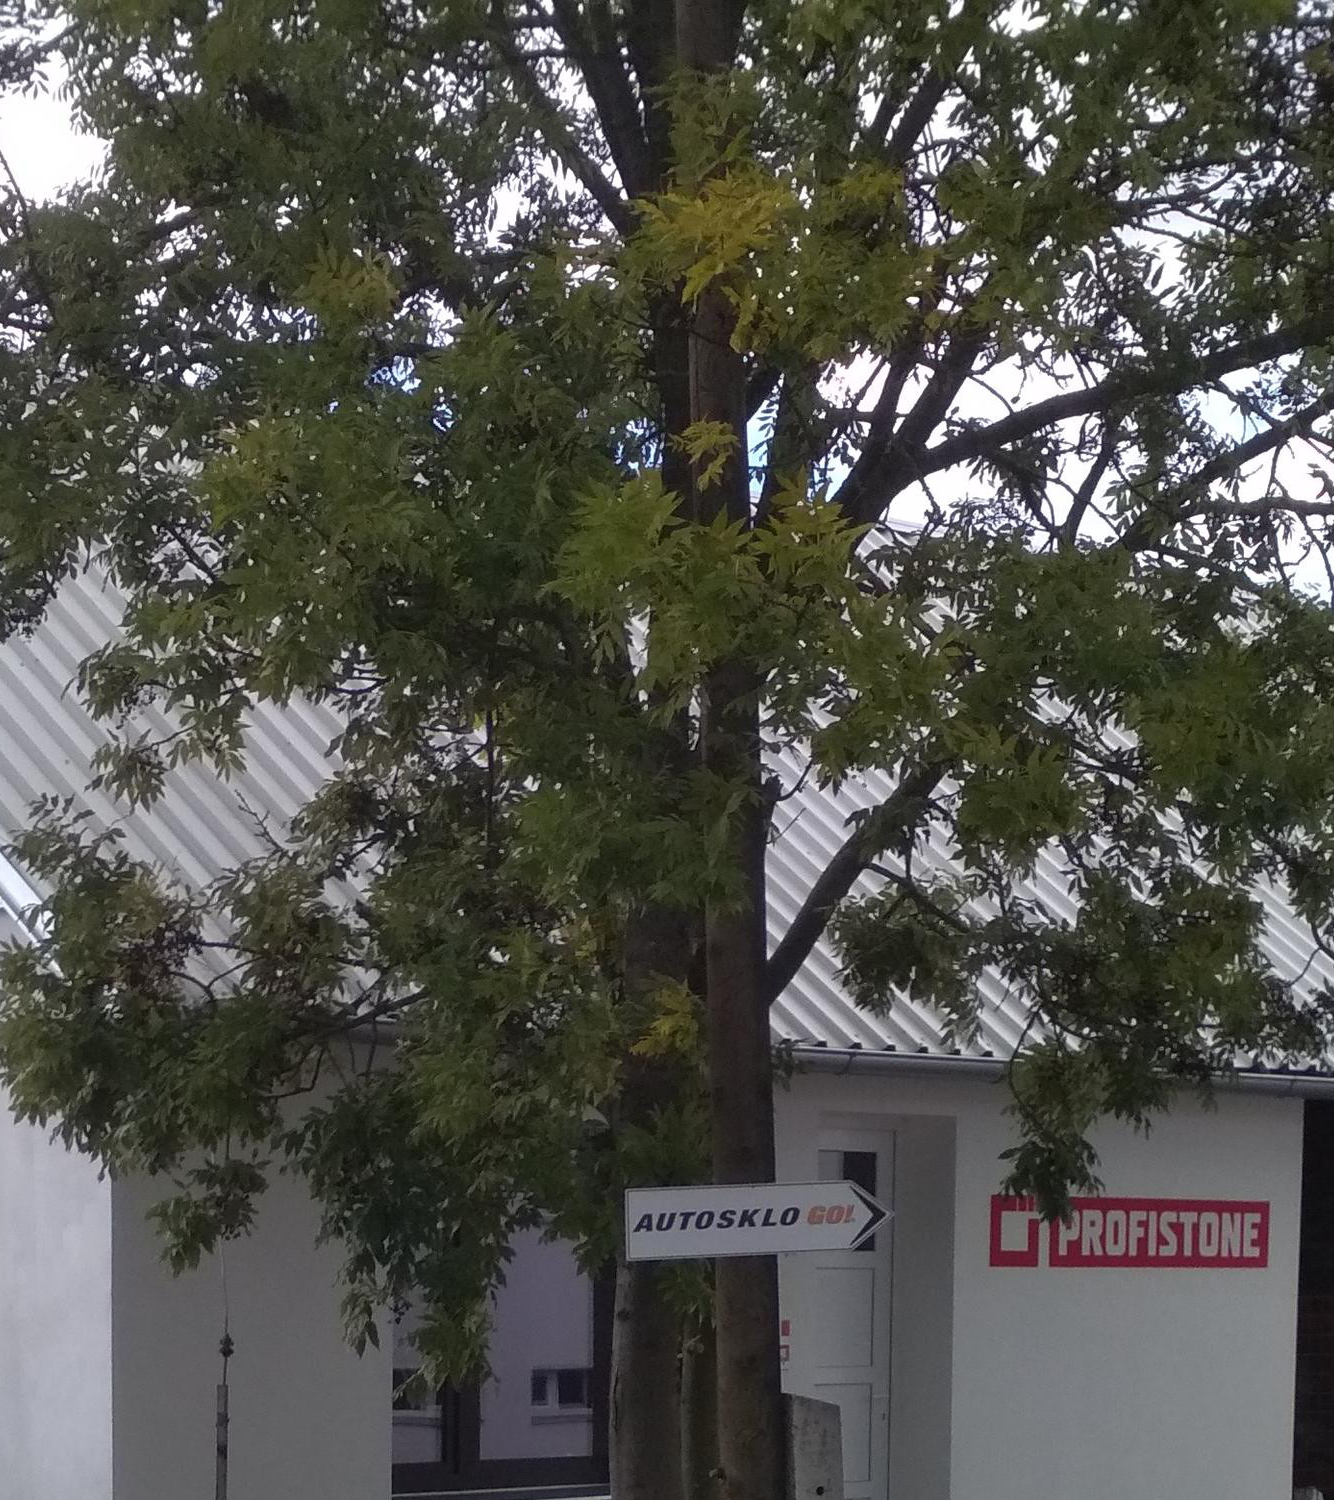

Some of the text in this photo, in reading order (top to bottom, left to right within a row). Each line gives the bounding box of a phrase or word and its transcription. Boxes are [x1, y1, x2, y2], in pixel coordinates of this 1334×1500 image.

[633, 1203, 856, 1233] AUTOSKLO GO!
[1058, 1208, 1262, 1258] PROFISTONE
